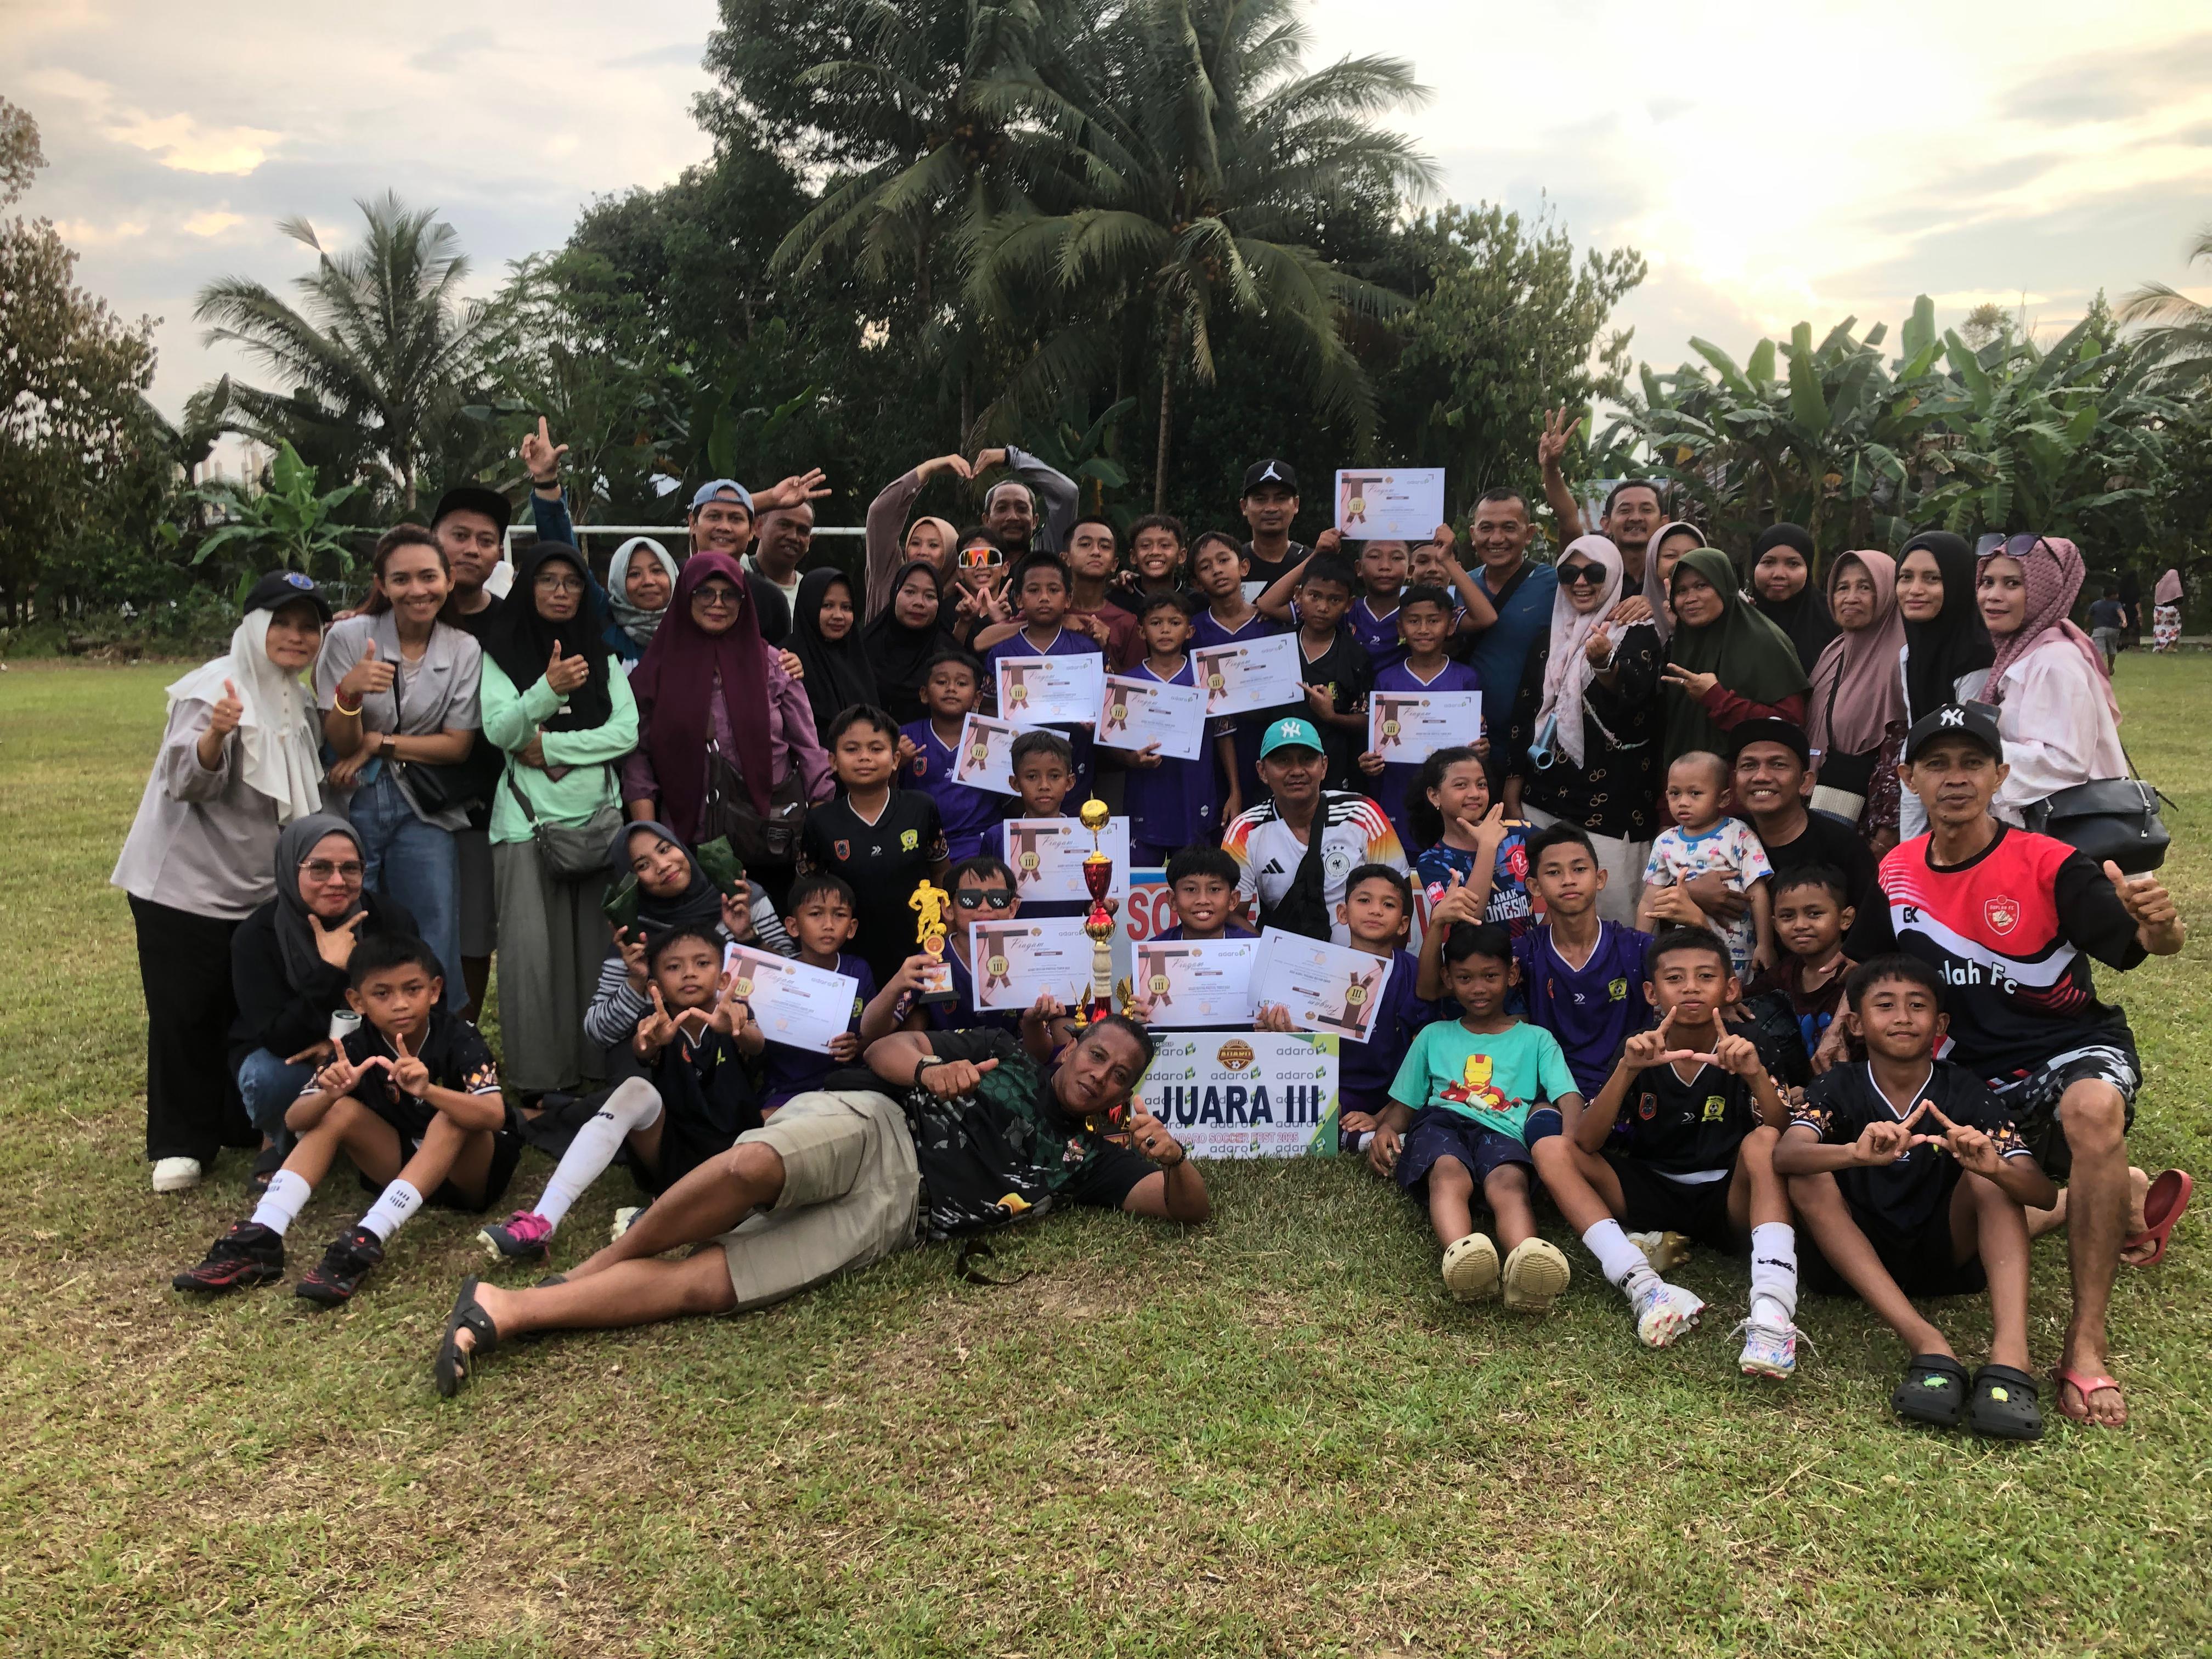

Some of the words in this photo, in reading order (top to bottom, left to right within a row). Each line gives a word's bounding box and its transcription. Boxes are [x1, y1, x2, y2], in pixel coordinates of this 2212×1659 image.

[1940, 708, 1965, 726] NY
[1281, 720, 1301, 737] NY
[1494, 888, 1519, 904] ANAK
[1485, 894, 1530, 923] ONESIA
[994, 963, 1003, 972] III
[1155, 982, 1164, 990] III
[1351, 989, 1362, 998] III
[1154, 1047, 1183, 1056] daro
[1277, 1047, 1314, 1056] adaro
[1145, 1071, 1183, 1081] adaro
[1211, 1071, 1249, 1080] adaro
[1277, 1070, 1314, 1080] adaro
[1153, 1086, 1273, 1125] JUARA
[1286, 1085, 1319, 1123] III
[1173, 1133, 1207, 1143] ADARO
[1209, 1132, 1249, 1143] SOCCER
[1251, 1132, 1276, 1143] FEST
[1277, 1132, 1299, 1143] 2025
[1210, 1143, 1248, 1153] adaro
